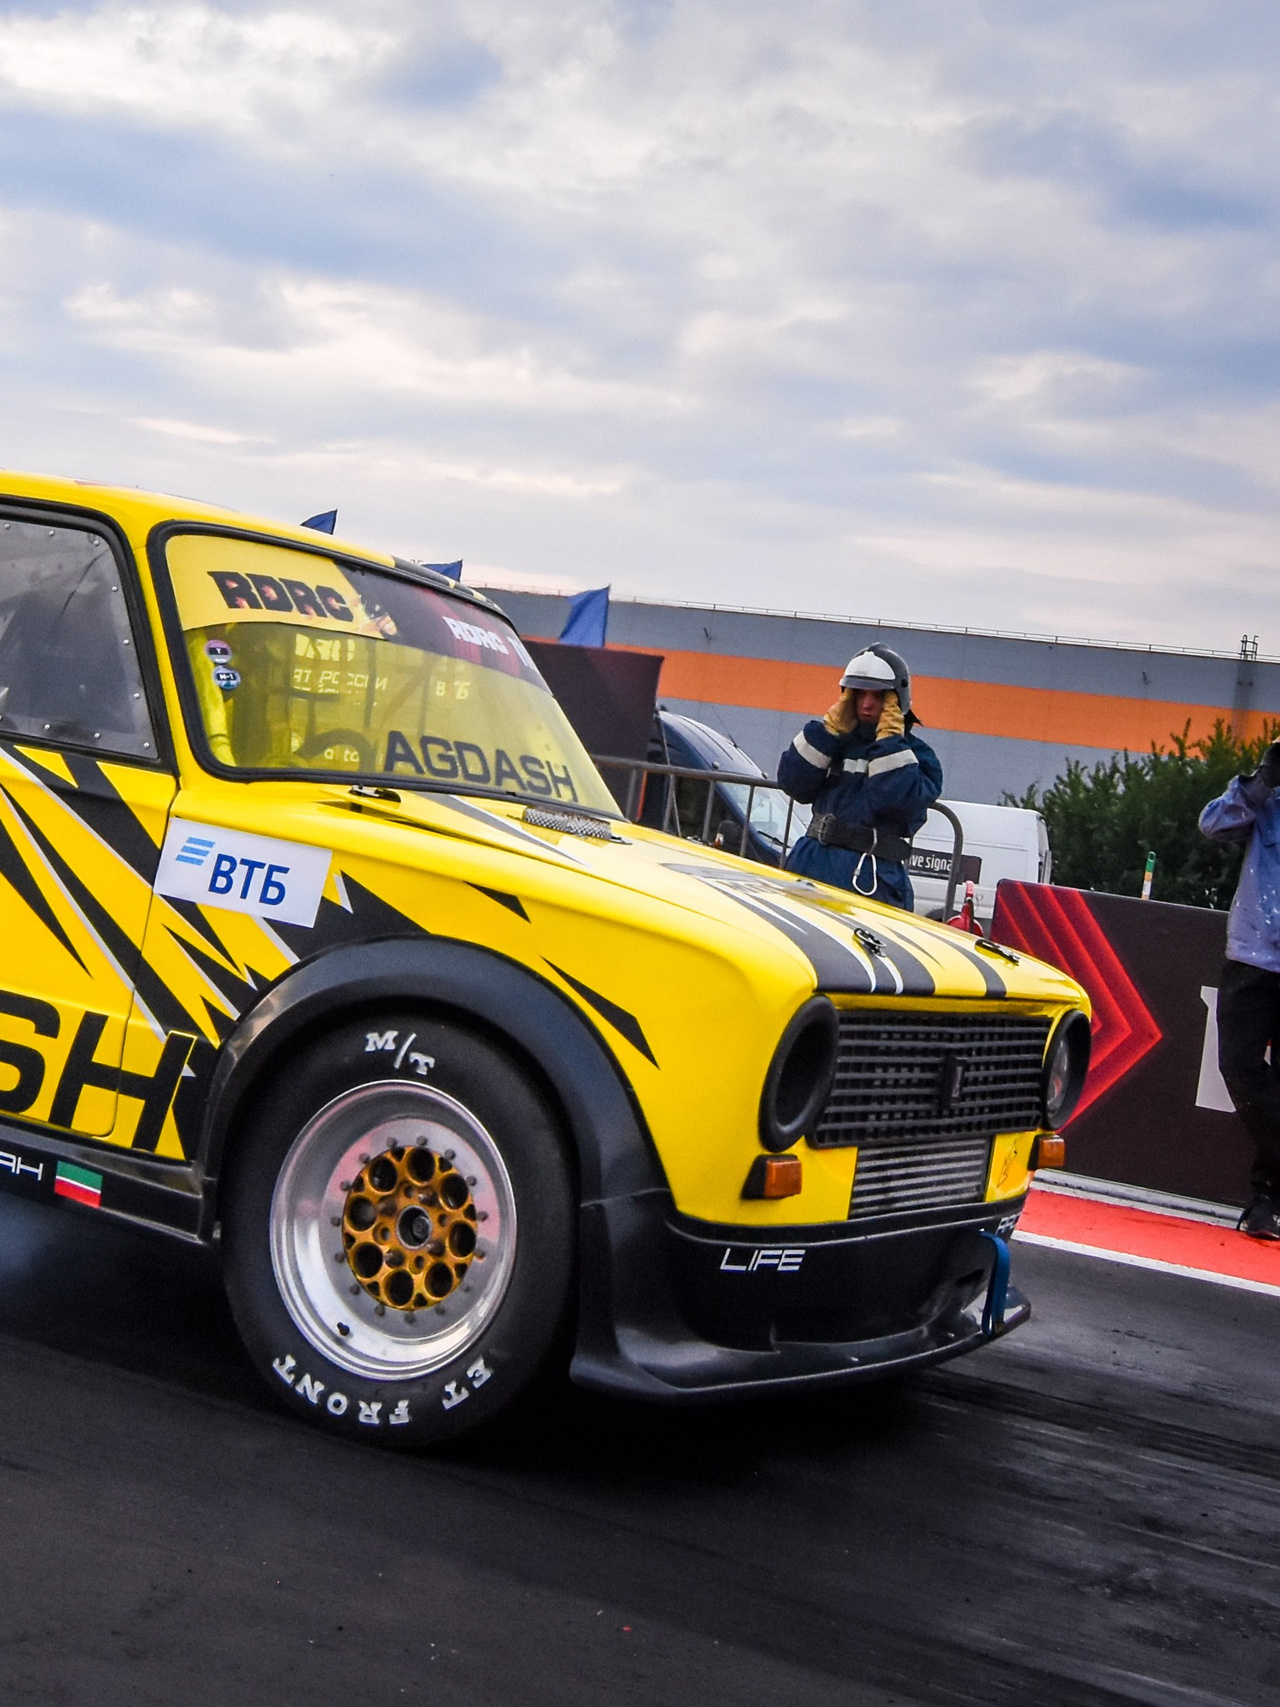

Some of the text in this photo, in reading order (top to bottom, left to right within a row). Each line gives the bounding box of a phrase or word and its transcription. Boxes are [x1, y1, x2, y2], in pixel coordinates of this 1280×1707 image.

[206, 570, 355, 623] RDRC
[442, 616, 509, 655] RDRC
[384, 730, 579, 803] AGDASH
[208, 853, 291, 906] ВТБ
[924, 854, 953, 872] signa
[365, 1029, 436, 1076] M/T
[720, 1247, 806, 1272] LIFE
[272, 1354, 494, 1424] ET FRONT
